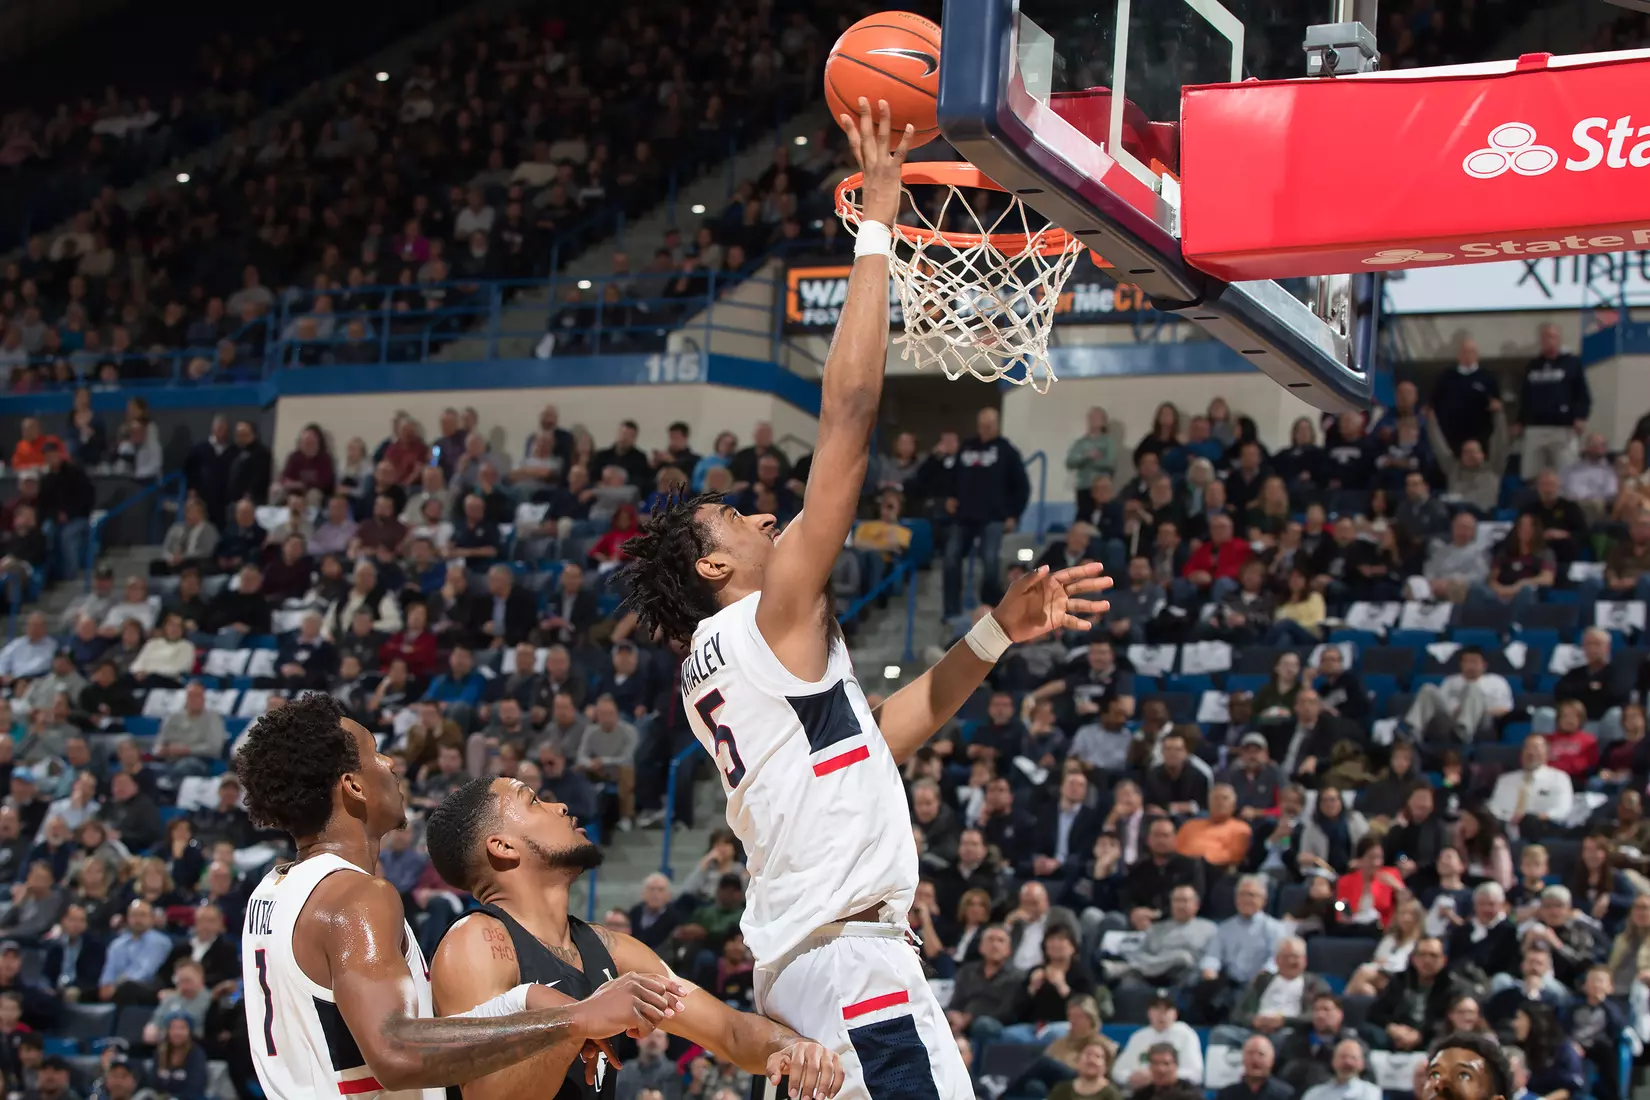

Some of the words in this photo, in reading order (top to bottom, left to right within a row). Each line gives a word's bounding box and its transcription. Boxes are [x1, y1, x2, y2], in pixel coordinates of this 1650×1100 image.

[1459, 235, 1625, 258] State
[693, 687, 746, 789] 5
[249, 899, 277, 935] VITAL
[254, 948, 278, 1057] 1
